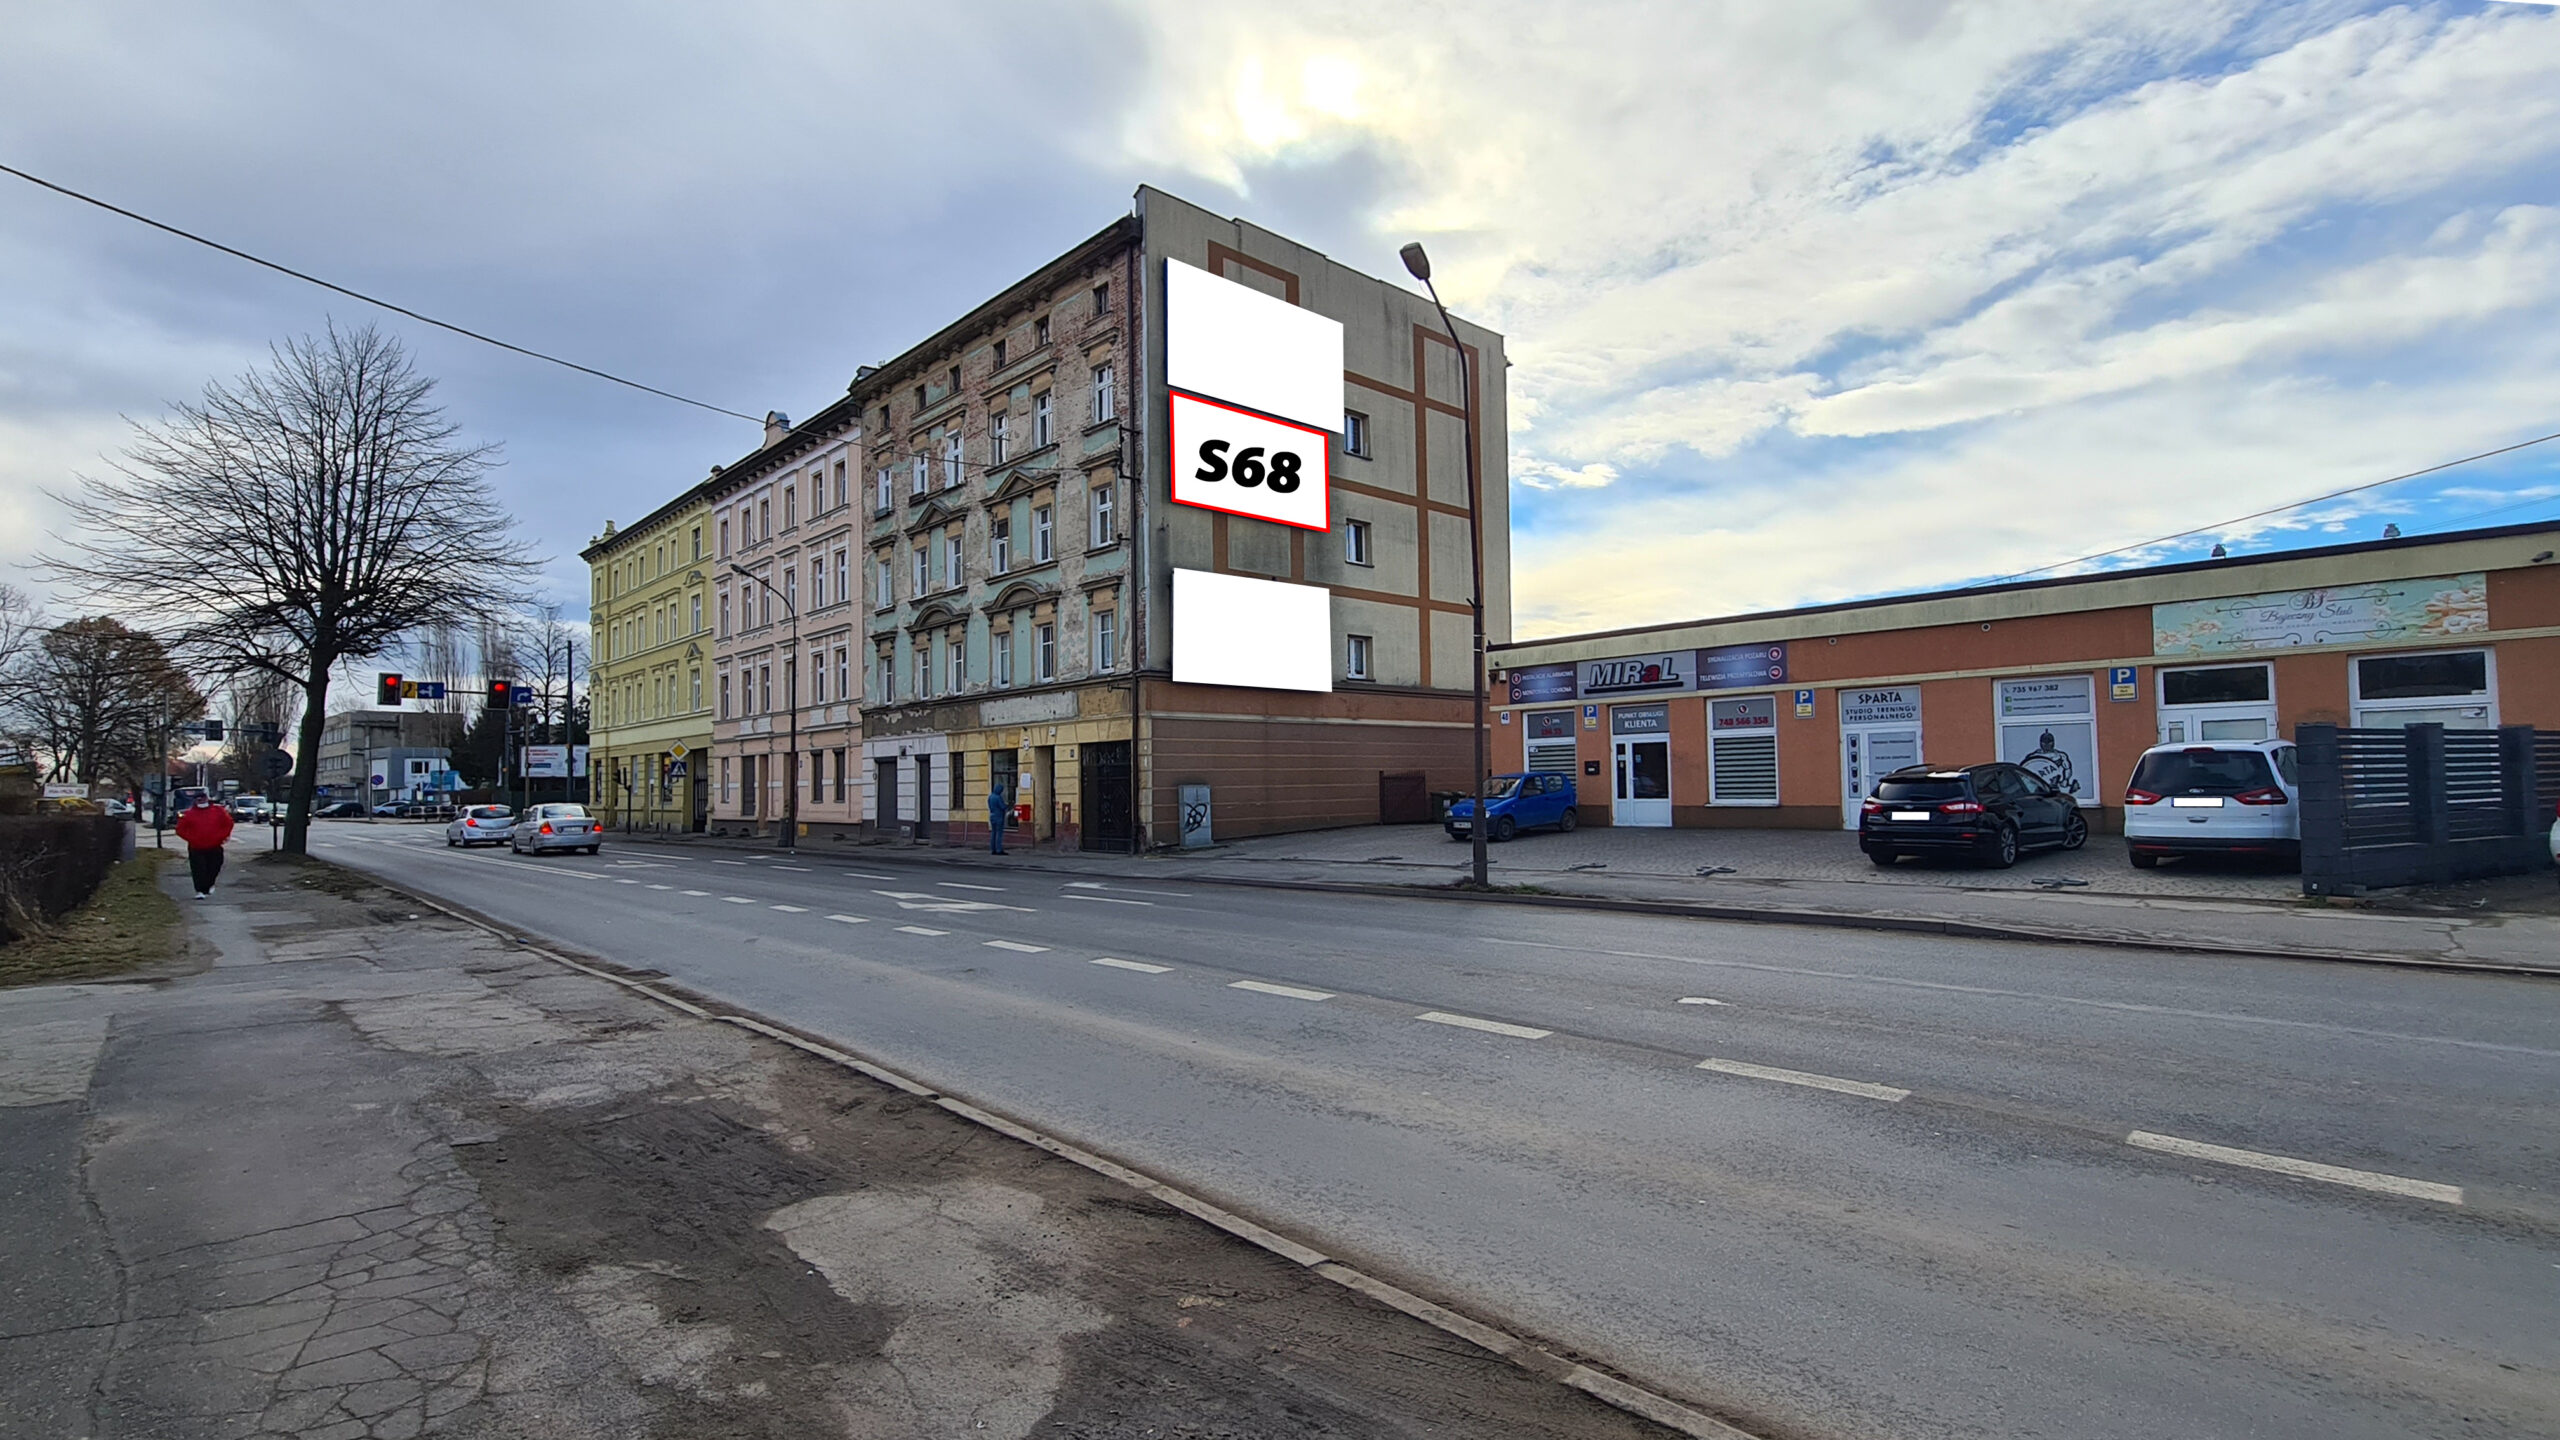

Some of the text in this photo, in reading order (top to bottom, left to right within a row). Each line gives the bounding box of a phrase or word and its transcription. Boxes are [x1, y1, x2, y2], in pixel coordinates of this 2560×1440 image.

[2117, 668, 2131, 683] P
[1800, 690, 1809, 703] P
[1858, 691, 1902, 704] SPARTA
[1586, 706, 1594, 717] P
[1845, 705, 1917, 715] STUDIO TRENINGU
[1617, 712, 1637, 720] PUNKT
[1849, 712, 1914, 721] PERSONALNEGO
[1624, 719, 1658, 729] KLIENTA
